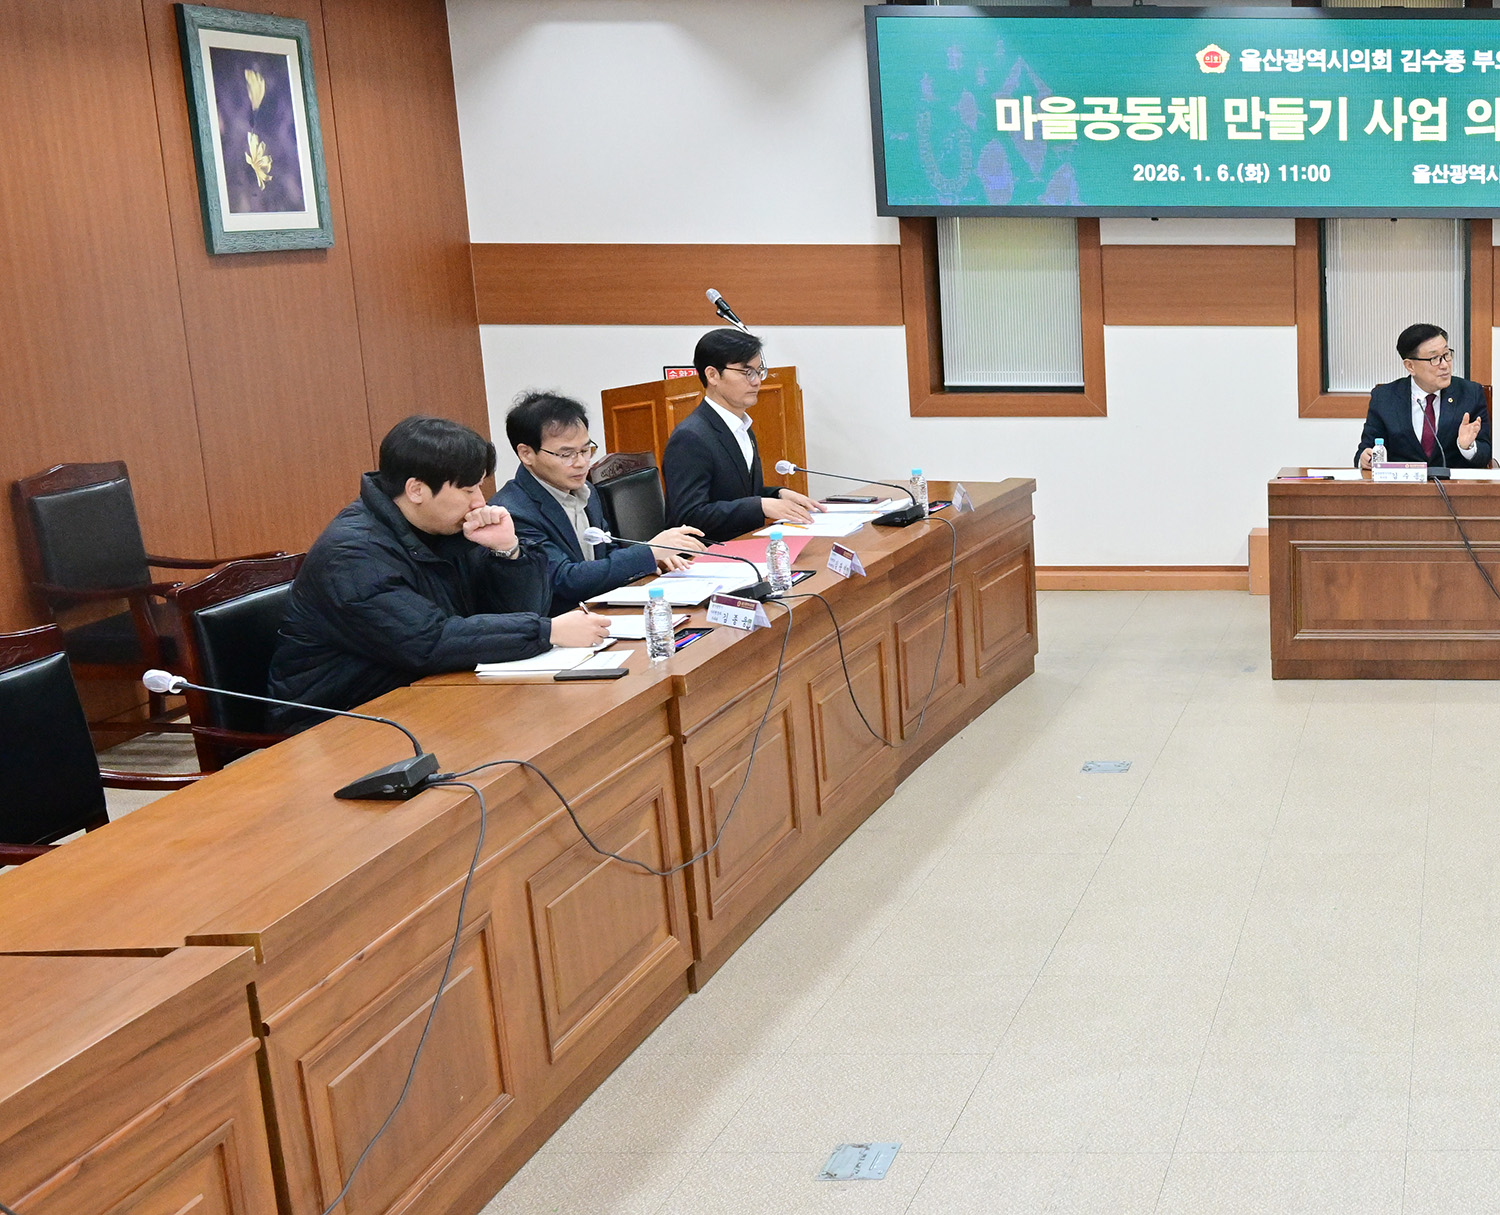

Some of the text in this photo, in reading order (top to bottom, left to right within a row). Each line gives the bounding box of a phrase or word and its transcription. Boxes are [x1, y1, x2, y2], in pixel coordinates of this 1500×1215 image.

[1239, 48, 1392, 73] 울산광역시의회
[1400, 49, 1466, 73] 김수종
[995, 95, 1208, 141] 마을공동체
[1224, 96, 1348, 141] 만들기
[1363, 96, 1448, 142] 사업
[1133, 163, 1331, 184] 2026. 1. 6.(화) 11:00
